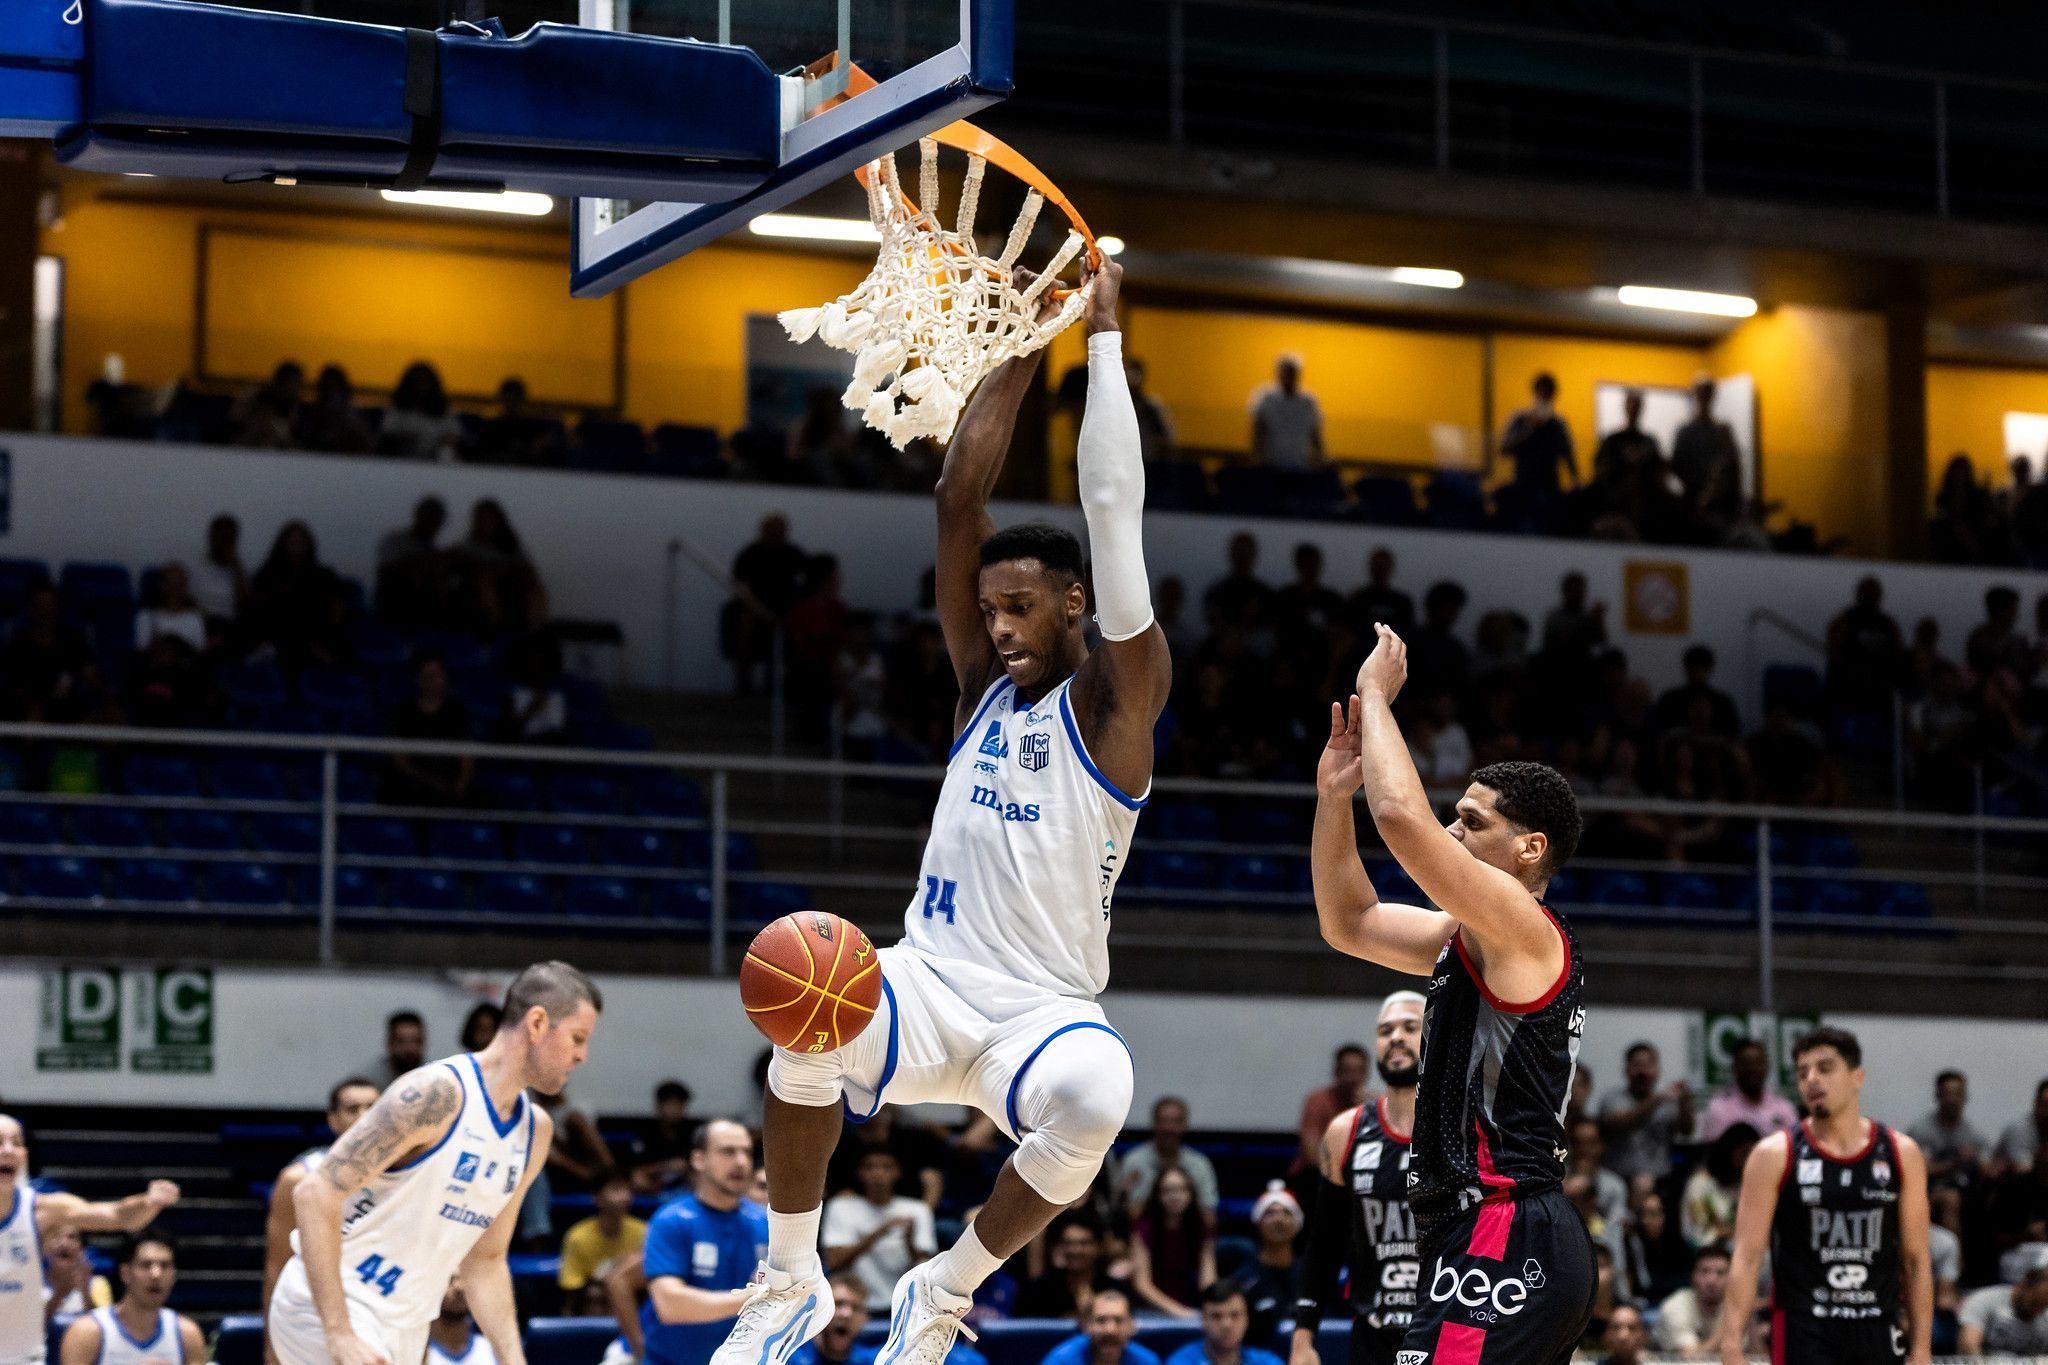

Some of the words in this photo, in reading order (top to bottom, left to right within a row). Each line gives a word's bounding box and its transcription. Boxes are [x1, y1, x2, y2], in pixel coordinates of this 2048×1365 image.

[922, 874, 957, 925] 24
[68, 971, 116, 1021] D
[161, 972, 208, 1024] C
[355, 1252, 405, 1297] 44
[1430, 1256, 1527, 1316] bee
[1469, 1309, 1498, 1324] vale
